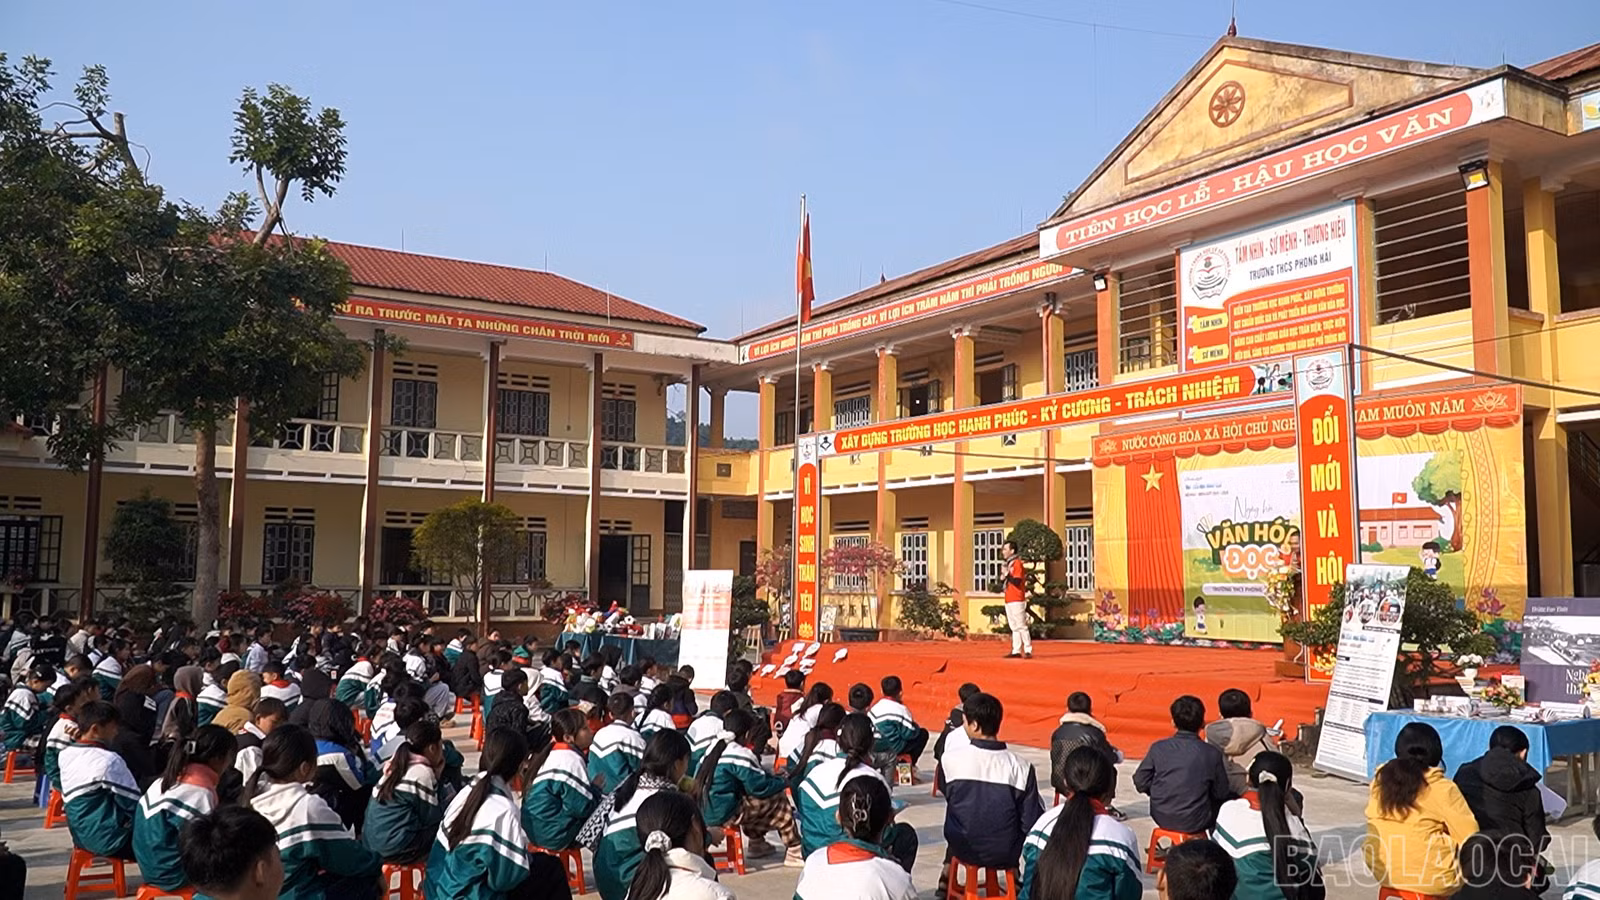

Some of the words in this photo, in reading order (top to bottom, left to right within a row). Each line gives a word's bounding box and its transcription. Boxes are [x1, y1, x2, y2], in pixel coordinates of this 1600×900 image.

[1066, 217, 1117, 244] TIÊN
[1123, 200, 1172, 227] HỌC
[1178, 180, 1211, 209] LỄ
[1232, 163, 1293, 192] HẬU
[1302, 136, 1368, 170] HỌC
[1377, 108, 1454, 144] VĂN
[1276, 261, 1293, 274] THCS
[1294, 254, 1318, 271] PHONG
[976, 277, 998, 295] PHẢI
[355, 306, 374, 316] RA
[378, 307, 422, 322] TRƯỚC
[457, 316, 473, 328] TA
[522, 324, 556, 338] CHÂN
[587, 332, 610, 344] MỚI
[841, 433, 860, 450] XÂY
[861, 430, 888, 447] DỰNG
[890, 424, 931, 443] TRƯỜNG
[933, 421, 956, 440] HỌC
[959, 415, 992, 436] HẠNH
[994, 408, 1028, 429] PHÚC
[1040, 400, 1059, 422] KỶ
[1062, 397, 1112, 418] CƯƠNG
[1125, 386, 1178, 409] TRÁCH
[1182, 375, 1240, 400] NHIỆM
[1122, 434, 1148, 451] NƯỚC
[1149, 431, 1177, 449] CỘNG
[1179, 427, 1201, 443] HÒA
[1204, 424, 1221, 440] XÃ
[1222, 421, 1242, 441] HỘI
[1245, 415, 1269, 435] CHỦ
[1272, 417, 1296, 432] NGH
[1383, 400, 1426, 420] MUÔN
[1430, 396, 1465, 415] NĂM
[1312, 404, 1340, 446] ĐỔI
[1310, 454, 1342, 493] MỚI
[800, 506, 814, 528] HỌC
[1317, 506, 1340, 539] VÀ
[799, 535, 815, 553] SINH
[1207, 520, 1249, 549] VĂN
[798, 560, 816, 583] THÂN
[1225, 546, 1277, 577] ĐỌC
[800, 589, 813, 612] YÊU
[1566, 668, 1586, 684] Ngh
